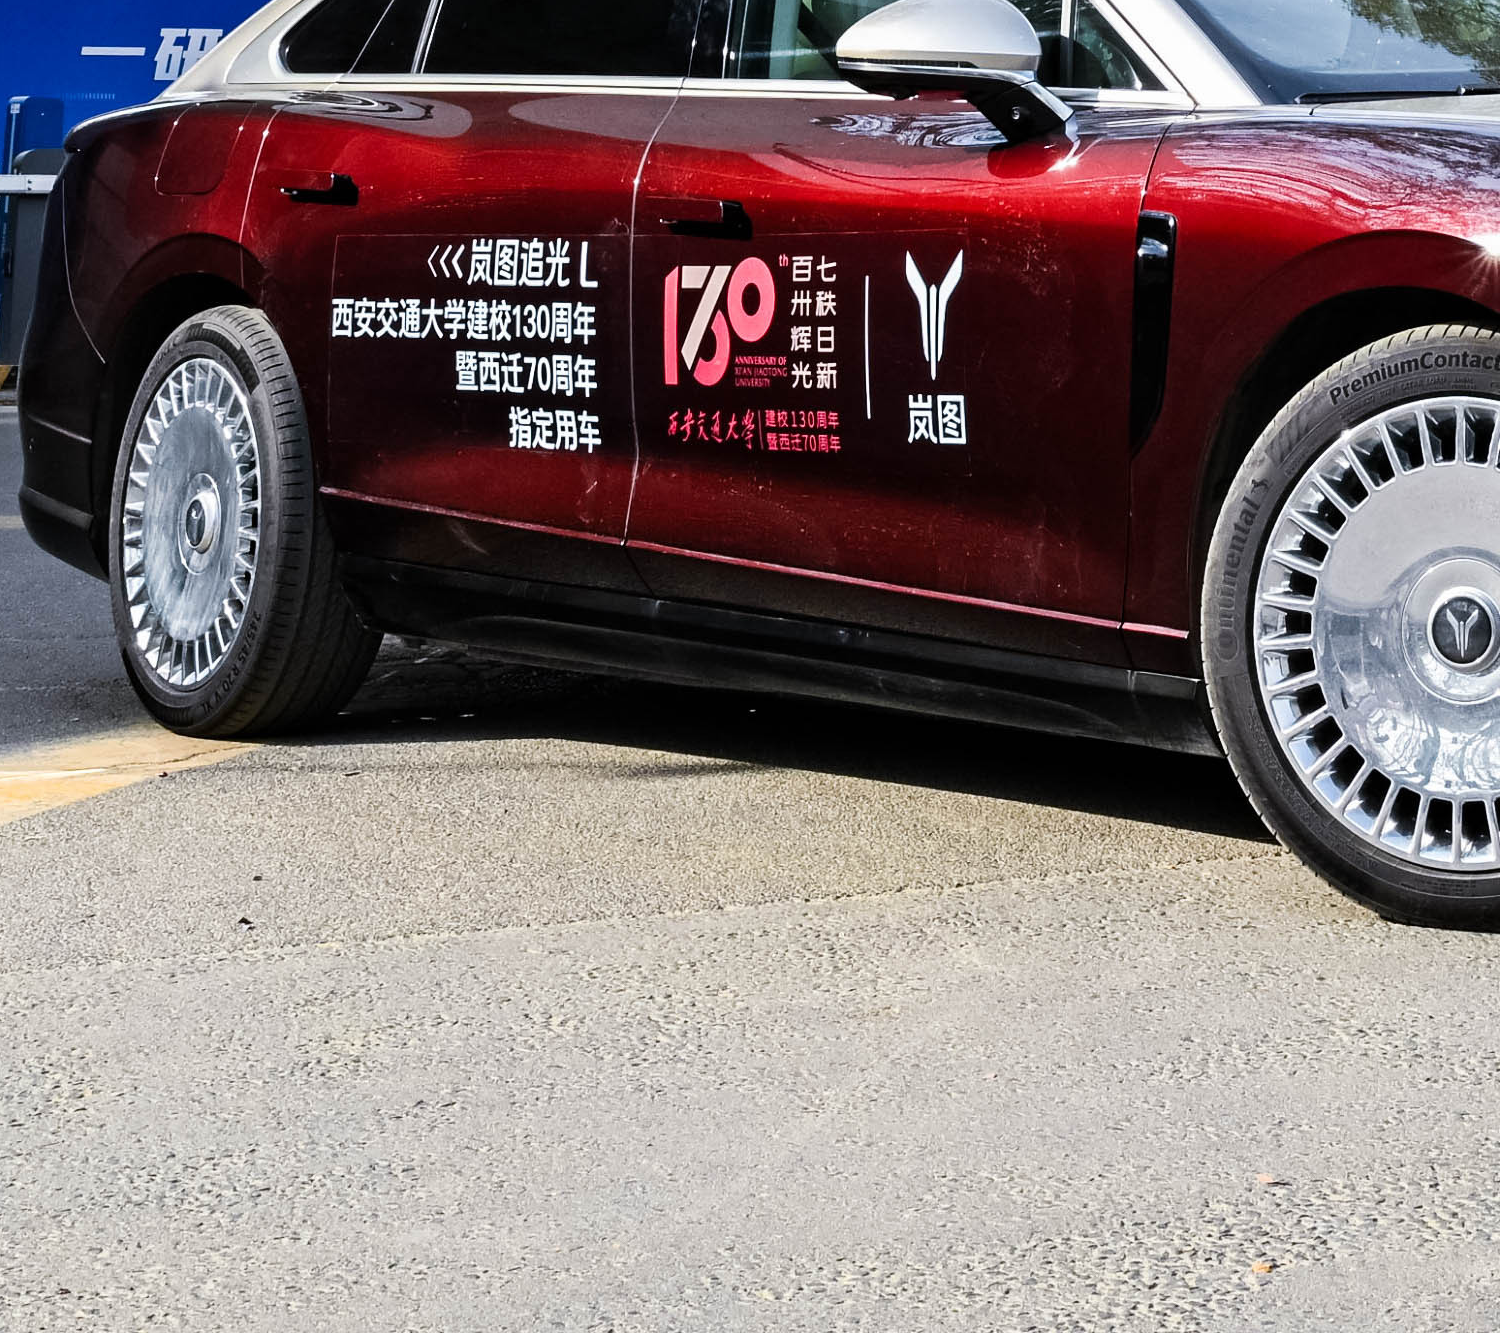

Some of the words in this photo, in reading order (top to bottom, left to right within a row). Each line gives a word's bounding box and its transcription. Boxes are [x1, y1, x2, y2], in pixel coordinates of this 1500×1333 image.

[467, 237, 571, 287] 岚图追光
[579, 241, 599, 289] L
[331, 297, 597, 345] 西安交通大学建校130周年
[815, 255, 837, 389] 七秩日新
[455, 350, 598, 398] 暨西迁70周年
[734, 356, 777, 366] ANNIVERSARY
[778, 356, 787, 366] OF
[734, 378, 770, 387] UNIVERSITY
[754, 367, 788, 377] JIAOTONG
[508, 406, 602, 454] 指定用车
[765, 409, 840, 429] 建校130周年
[766, 432, 842, 453] 暨西迁70周年
[907, 394, 968, 446] 岚图
[1214, 496, 1261, 662] Continental
